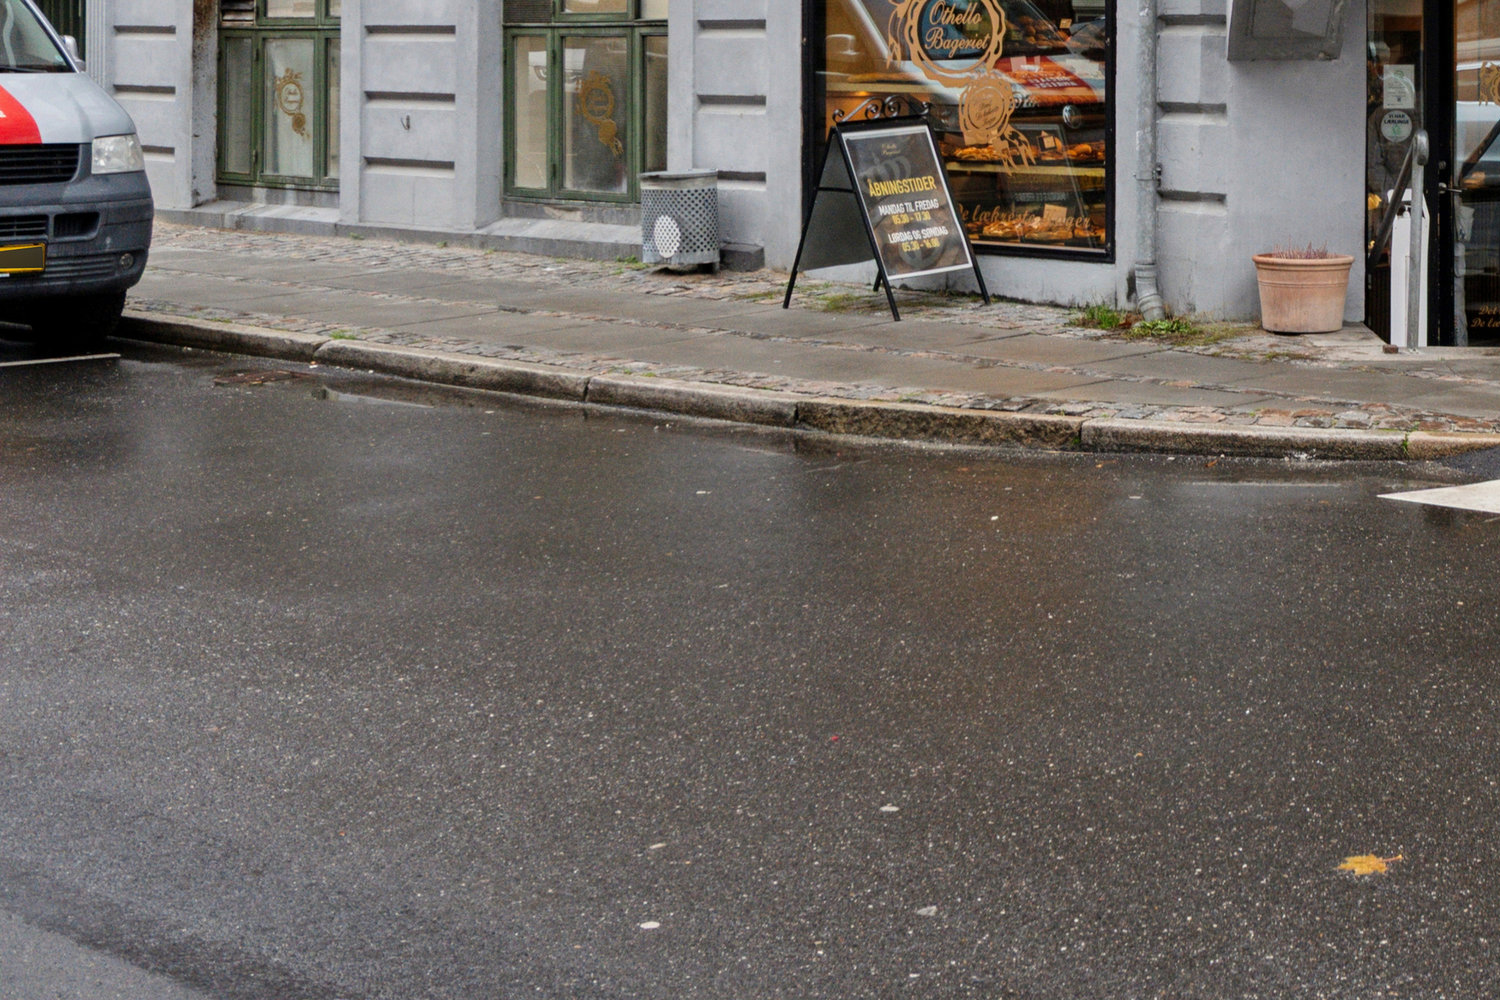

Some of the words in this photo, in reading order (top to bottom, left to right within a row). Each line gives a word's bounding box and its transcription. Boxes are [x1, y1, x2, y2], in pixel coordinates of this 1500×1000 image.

[929, 0, 983, 25] Othello
[925, 26, 991, 59] Bageriet
[867, 175, 937, 198] ÅBNINGSTIDER
[878, 202, 905, 216] MANDAG
[904, 201, 915, 213] TIL
[915, 198, 939, 211] FREDAG
[888, 230, 913, 244] LØRDAG
[912, 229, 922, 240] OG
[921, 226, 949, 239] SØNDAG
